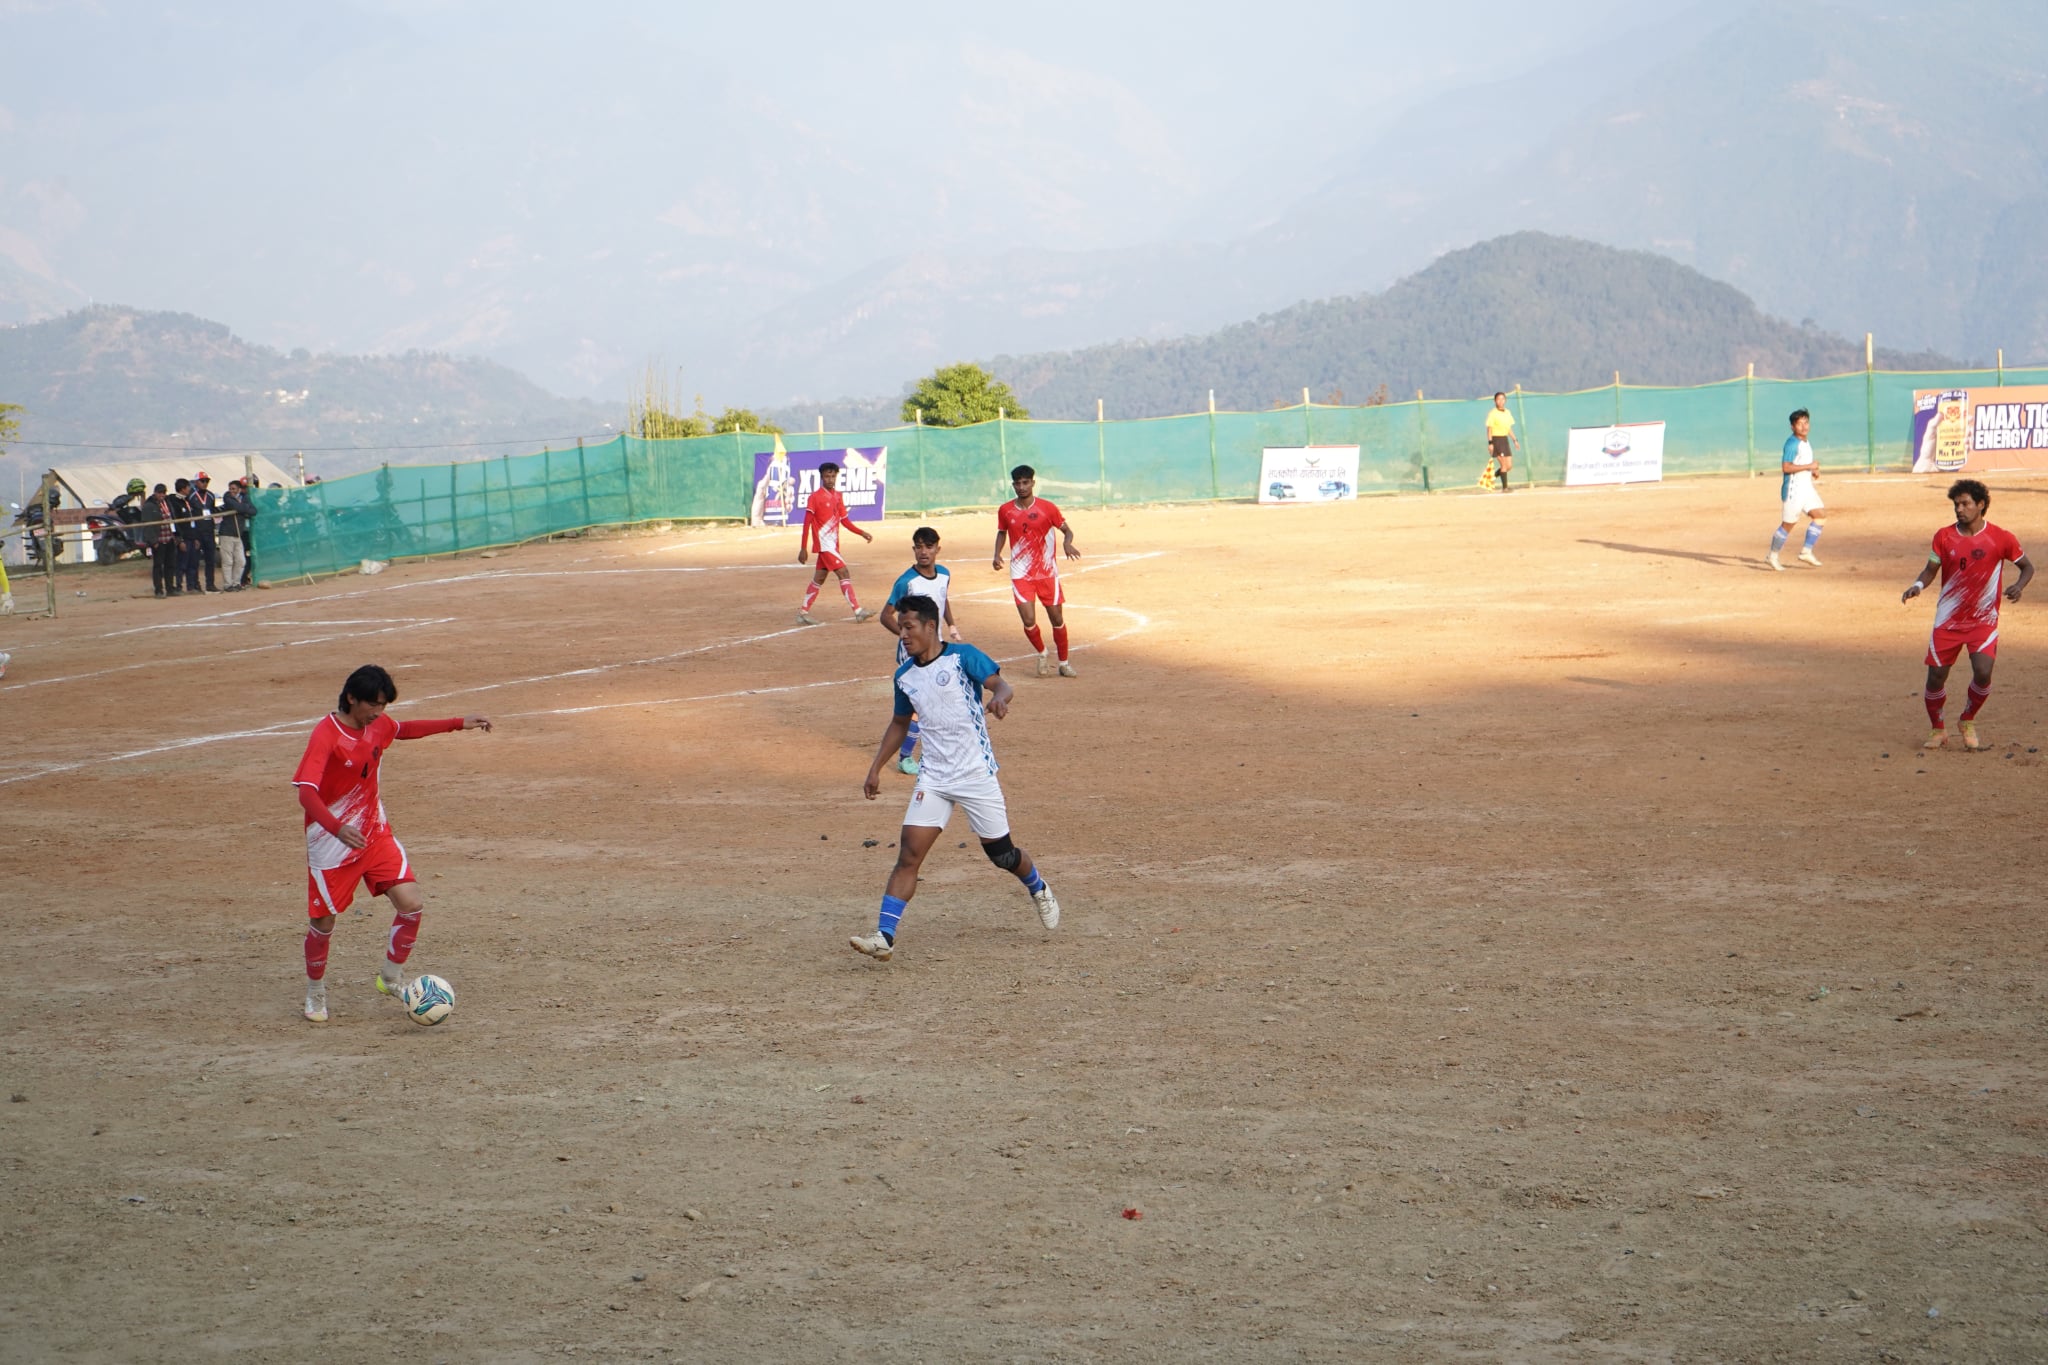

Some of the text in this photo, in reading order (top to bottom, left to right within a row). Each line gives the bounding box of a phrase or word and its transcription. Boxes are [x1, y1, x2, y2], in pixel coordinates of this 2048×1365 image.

[1976, 404, 2020, 430] MAX
[1975, 428, 2029, 449] ENERGY
[798, 467, 878, 494] XTEME
[1022, 523, 1029, 534] 2
[1959, 557, 1967, 572] 6
[360, 762, 369, 779] 4
